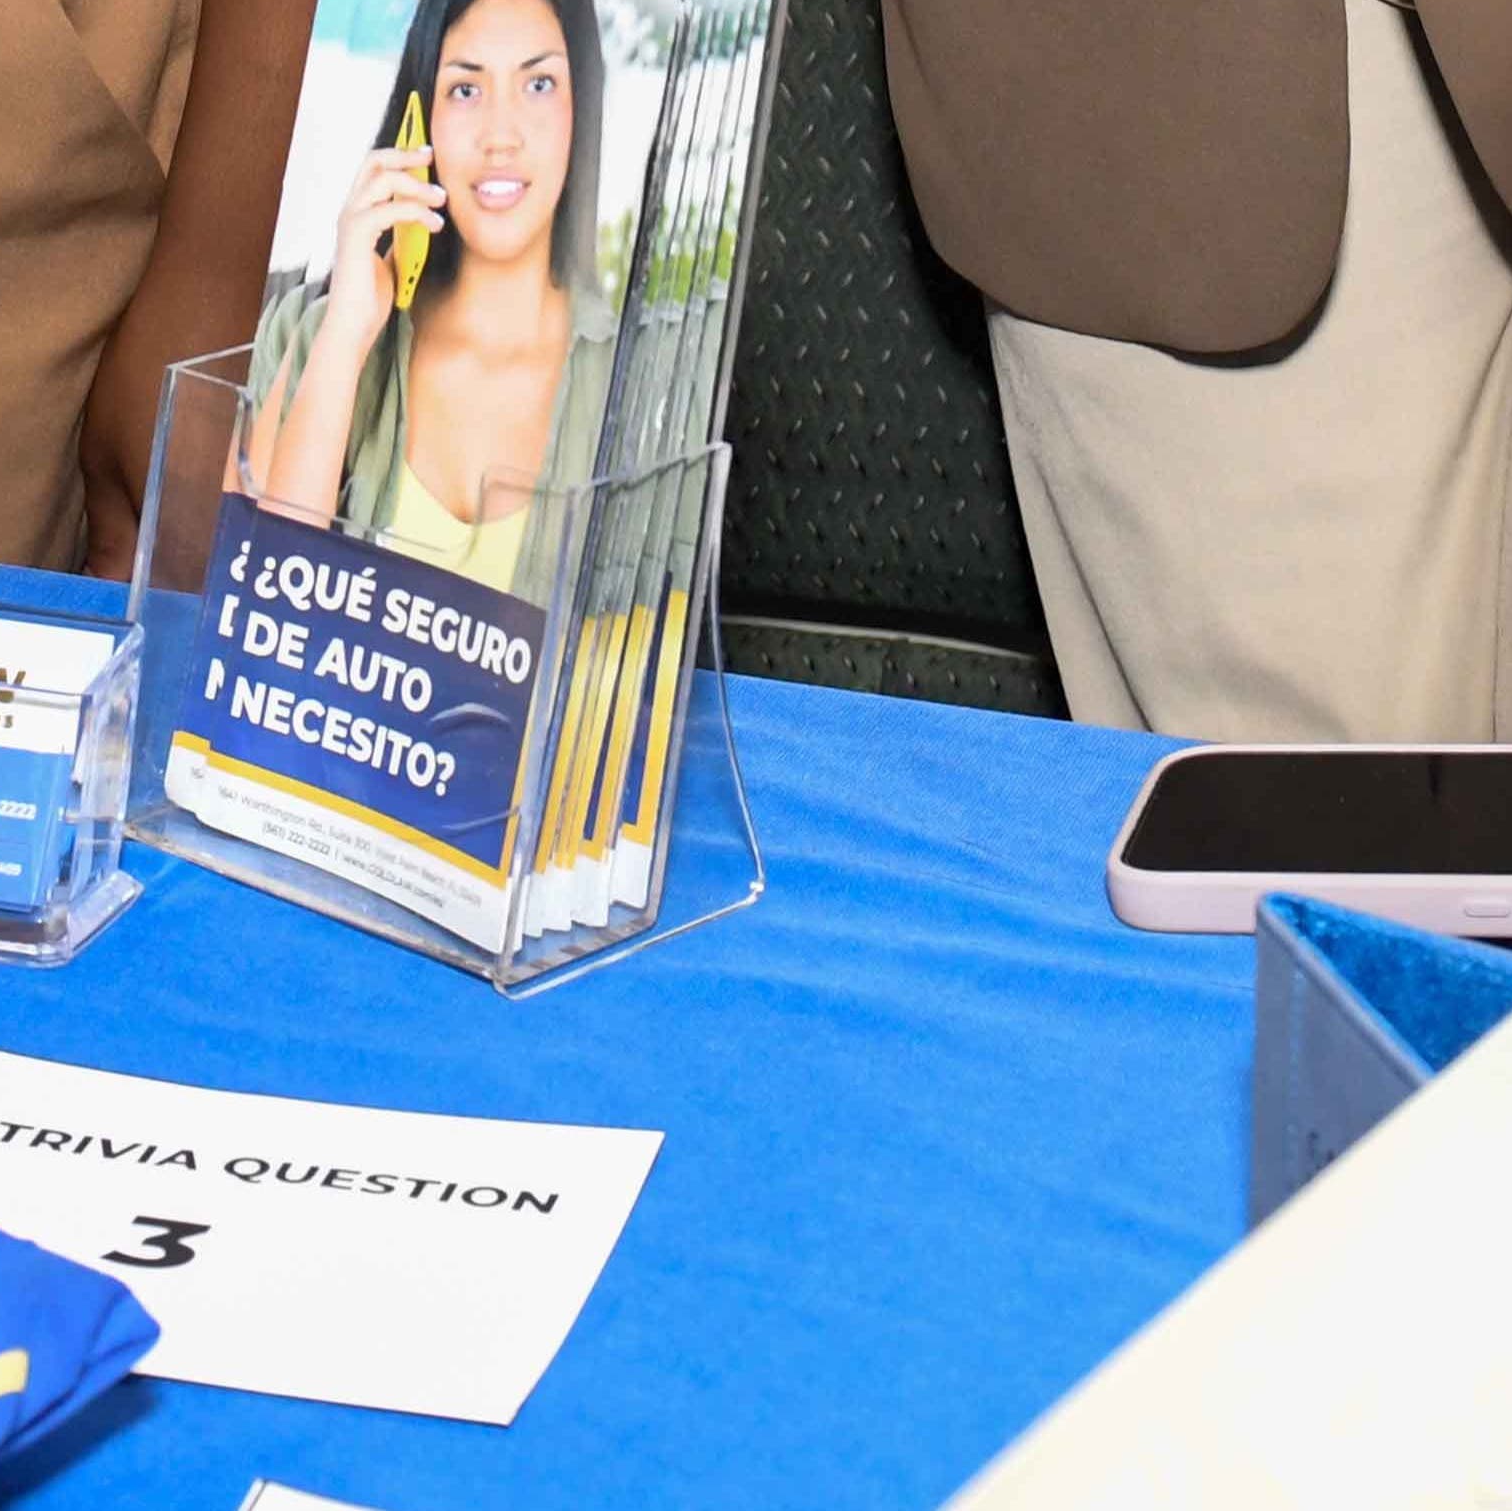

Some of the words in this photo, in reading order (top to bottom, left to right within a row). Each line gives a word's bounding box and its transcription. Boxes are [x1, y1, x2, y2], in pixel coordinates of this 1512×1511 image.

[243, 610, 310, 670] DE
[314, 636, 433, 714] AUTO
[255, 554, 376, 622] ¿QUÉ
[382, 589, 532, 685] SEGURO
[230, 674, 456, 797] NECESITO?
[222, 1154, 560, 1216] QUESTION
[99, 1215, 213, 1271] 3
